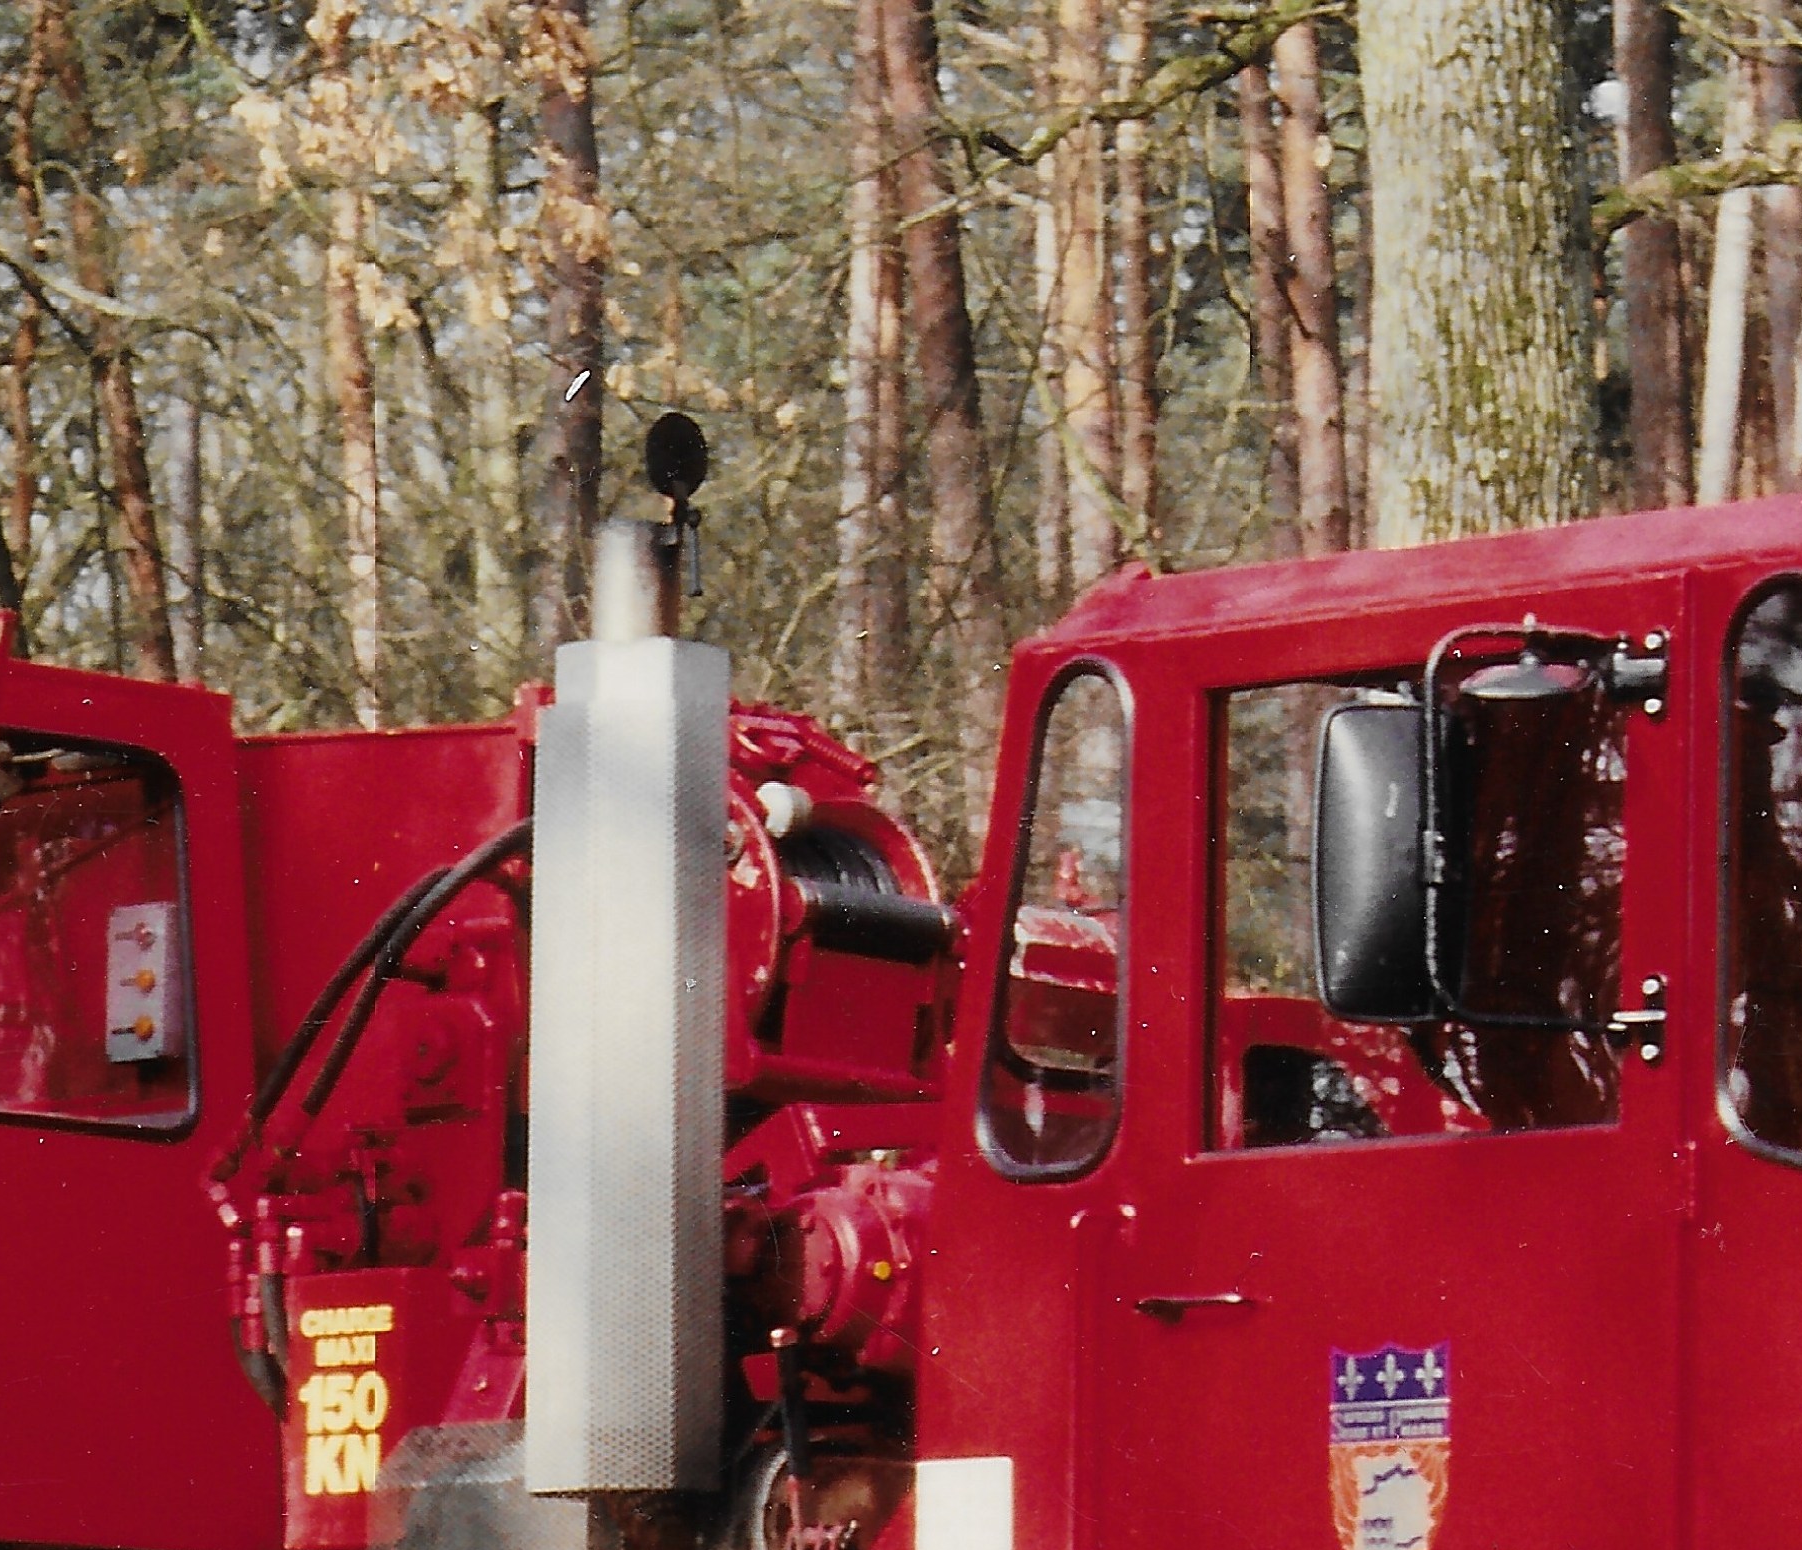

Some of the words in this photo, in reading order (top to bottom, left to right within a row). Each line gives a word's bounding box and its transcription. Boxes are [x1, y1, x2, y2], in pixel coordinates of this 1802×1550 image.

[300, 1305, 394, 1337] CHARGE
[298, 1370, 389, 1434] 150
[304, 1432, 381, 1496] KN
